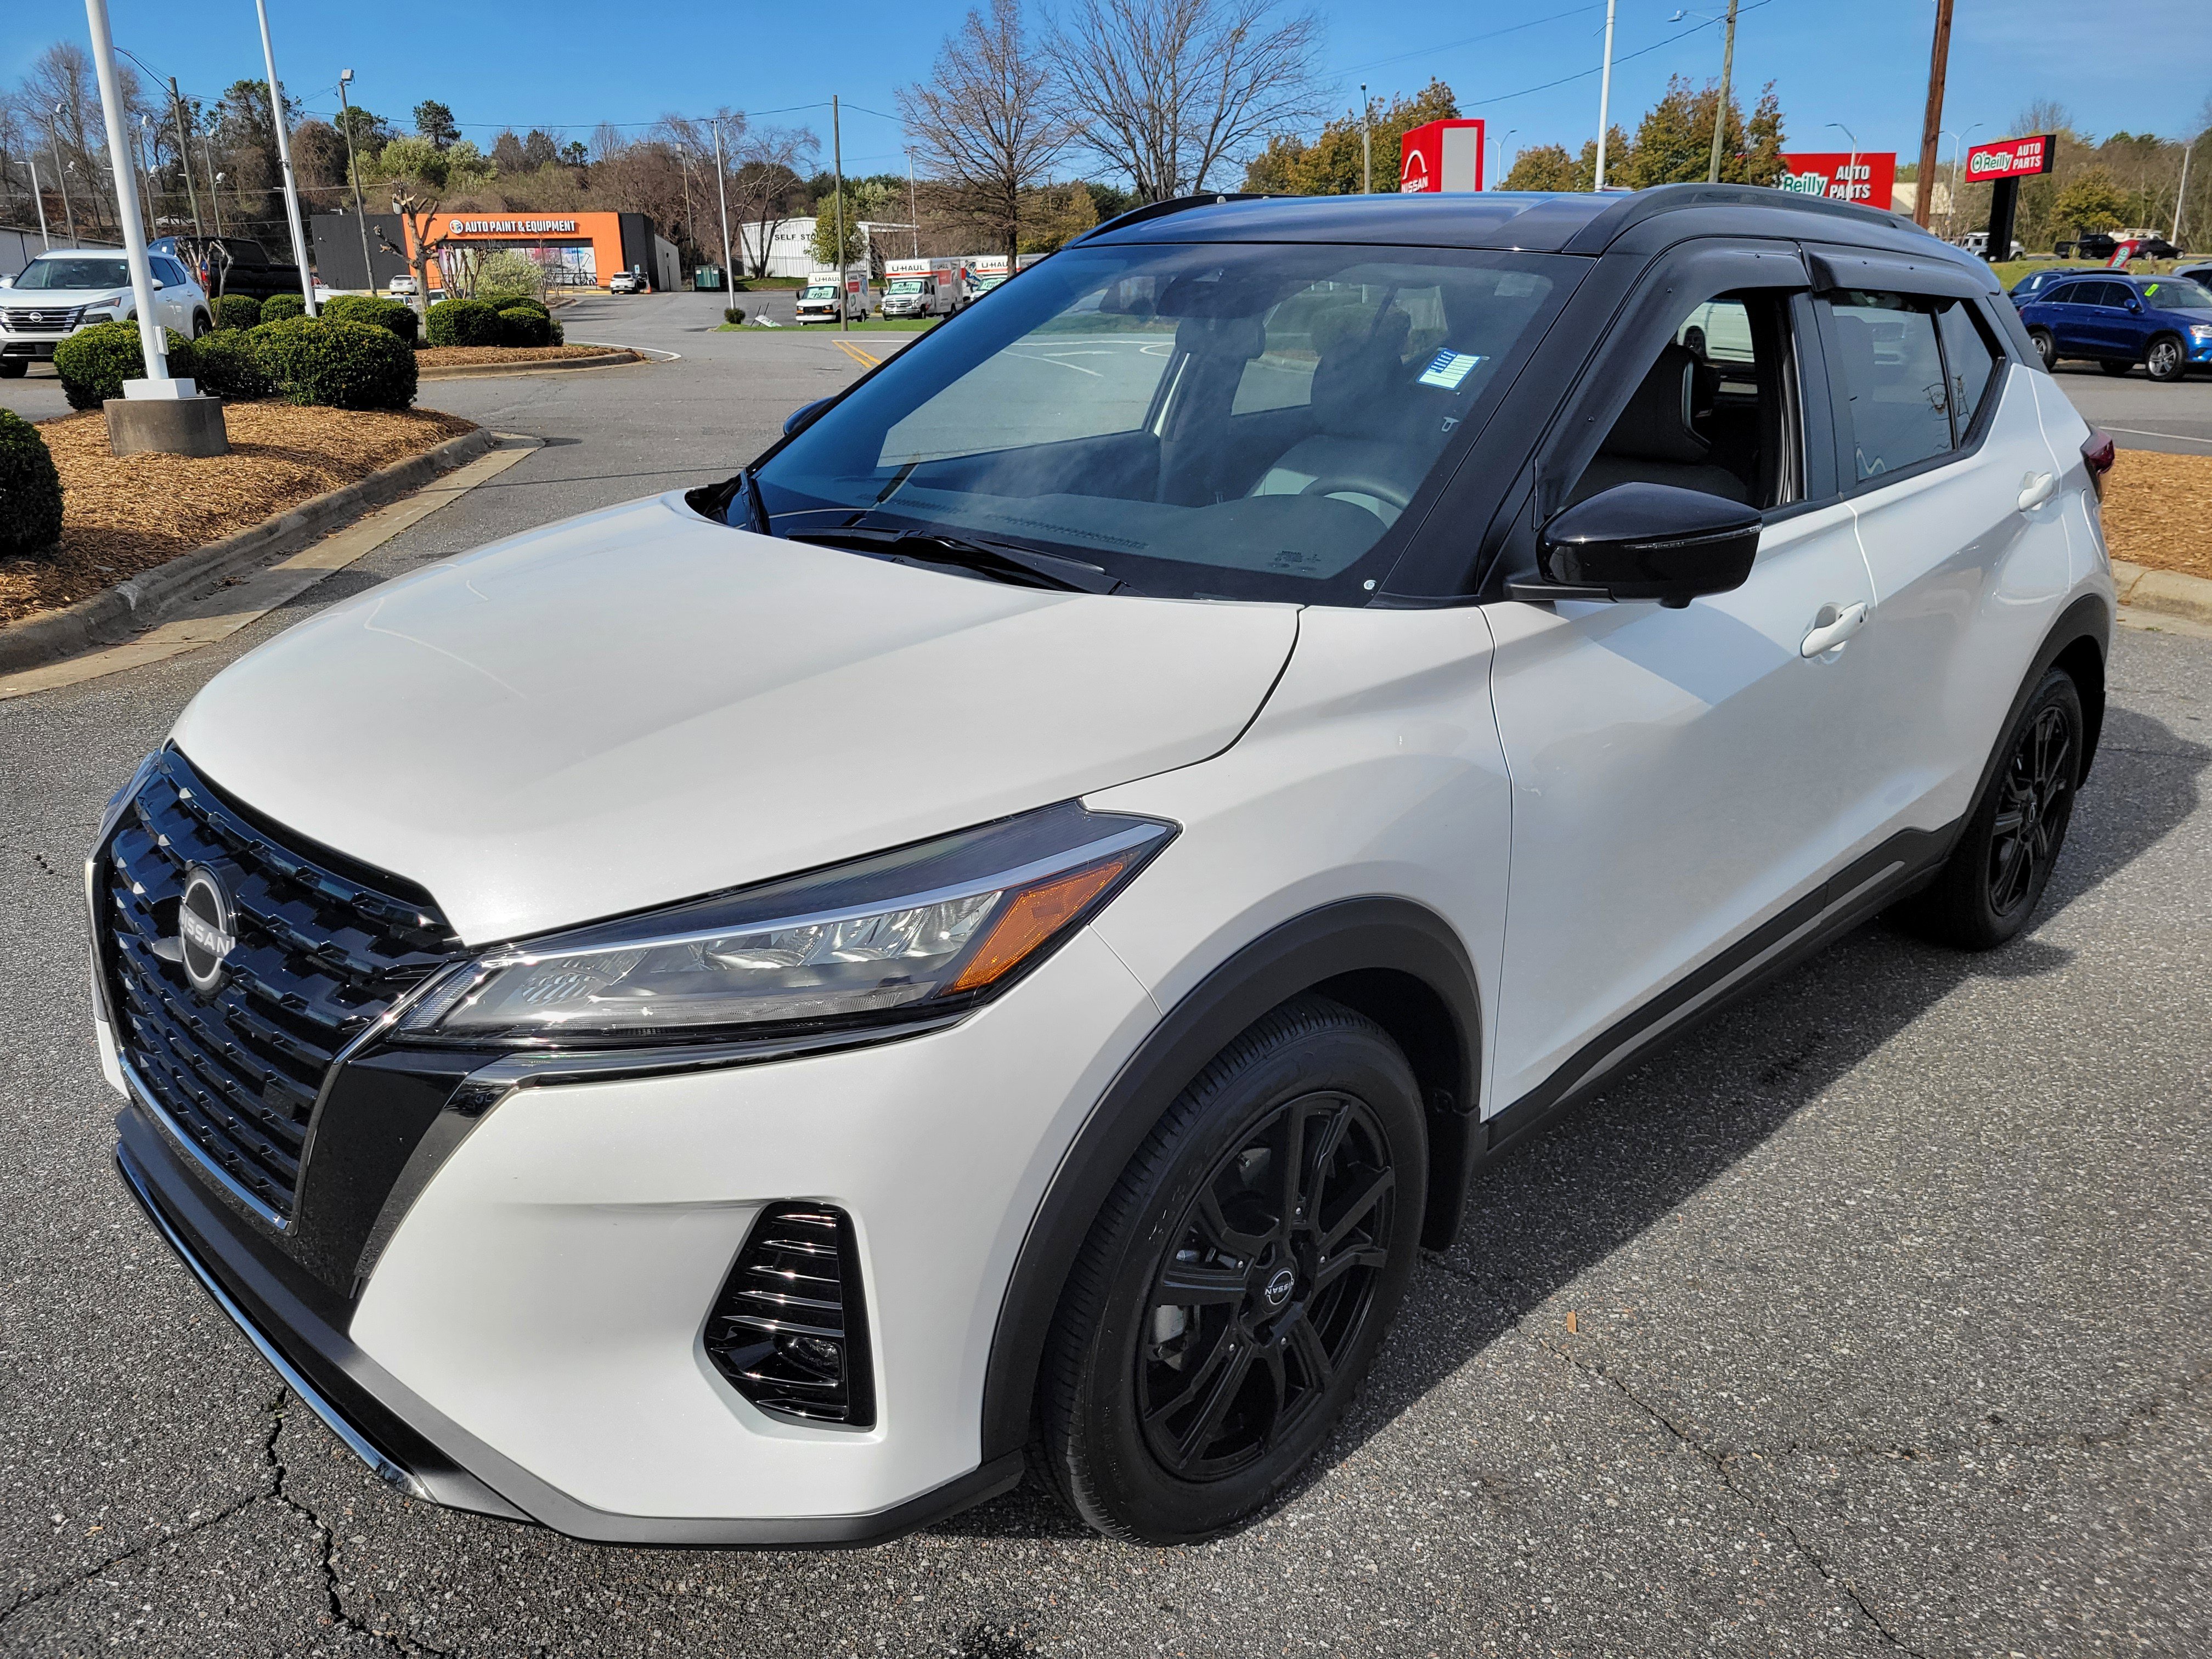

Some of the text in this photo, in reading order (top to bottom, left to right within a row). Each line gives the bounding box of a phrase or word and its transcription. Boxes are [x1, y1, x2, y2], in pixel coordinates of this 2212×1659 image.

[2017, 143, 2041, 156] AUTO
[1972, 152, 2013, 172] O'Reilly
[2012, 156, 2041, 170] PARTS
[1835, 165, 1870, 180] AUTO
[1401, 176, 1428, 193] NISSAN
[1782, 173, 1826, 196] Reilly
[465, 221, 488, 232] AUTO
[490, 221, 516, 232] PAINT
[517, 221, 525, 233] &
[526, 220, 575, 233] EQUIPMENT
[179, 905, 231, 956] NISSAN
[1265, 1280, 1294, 1295] NISSAN
